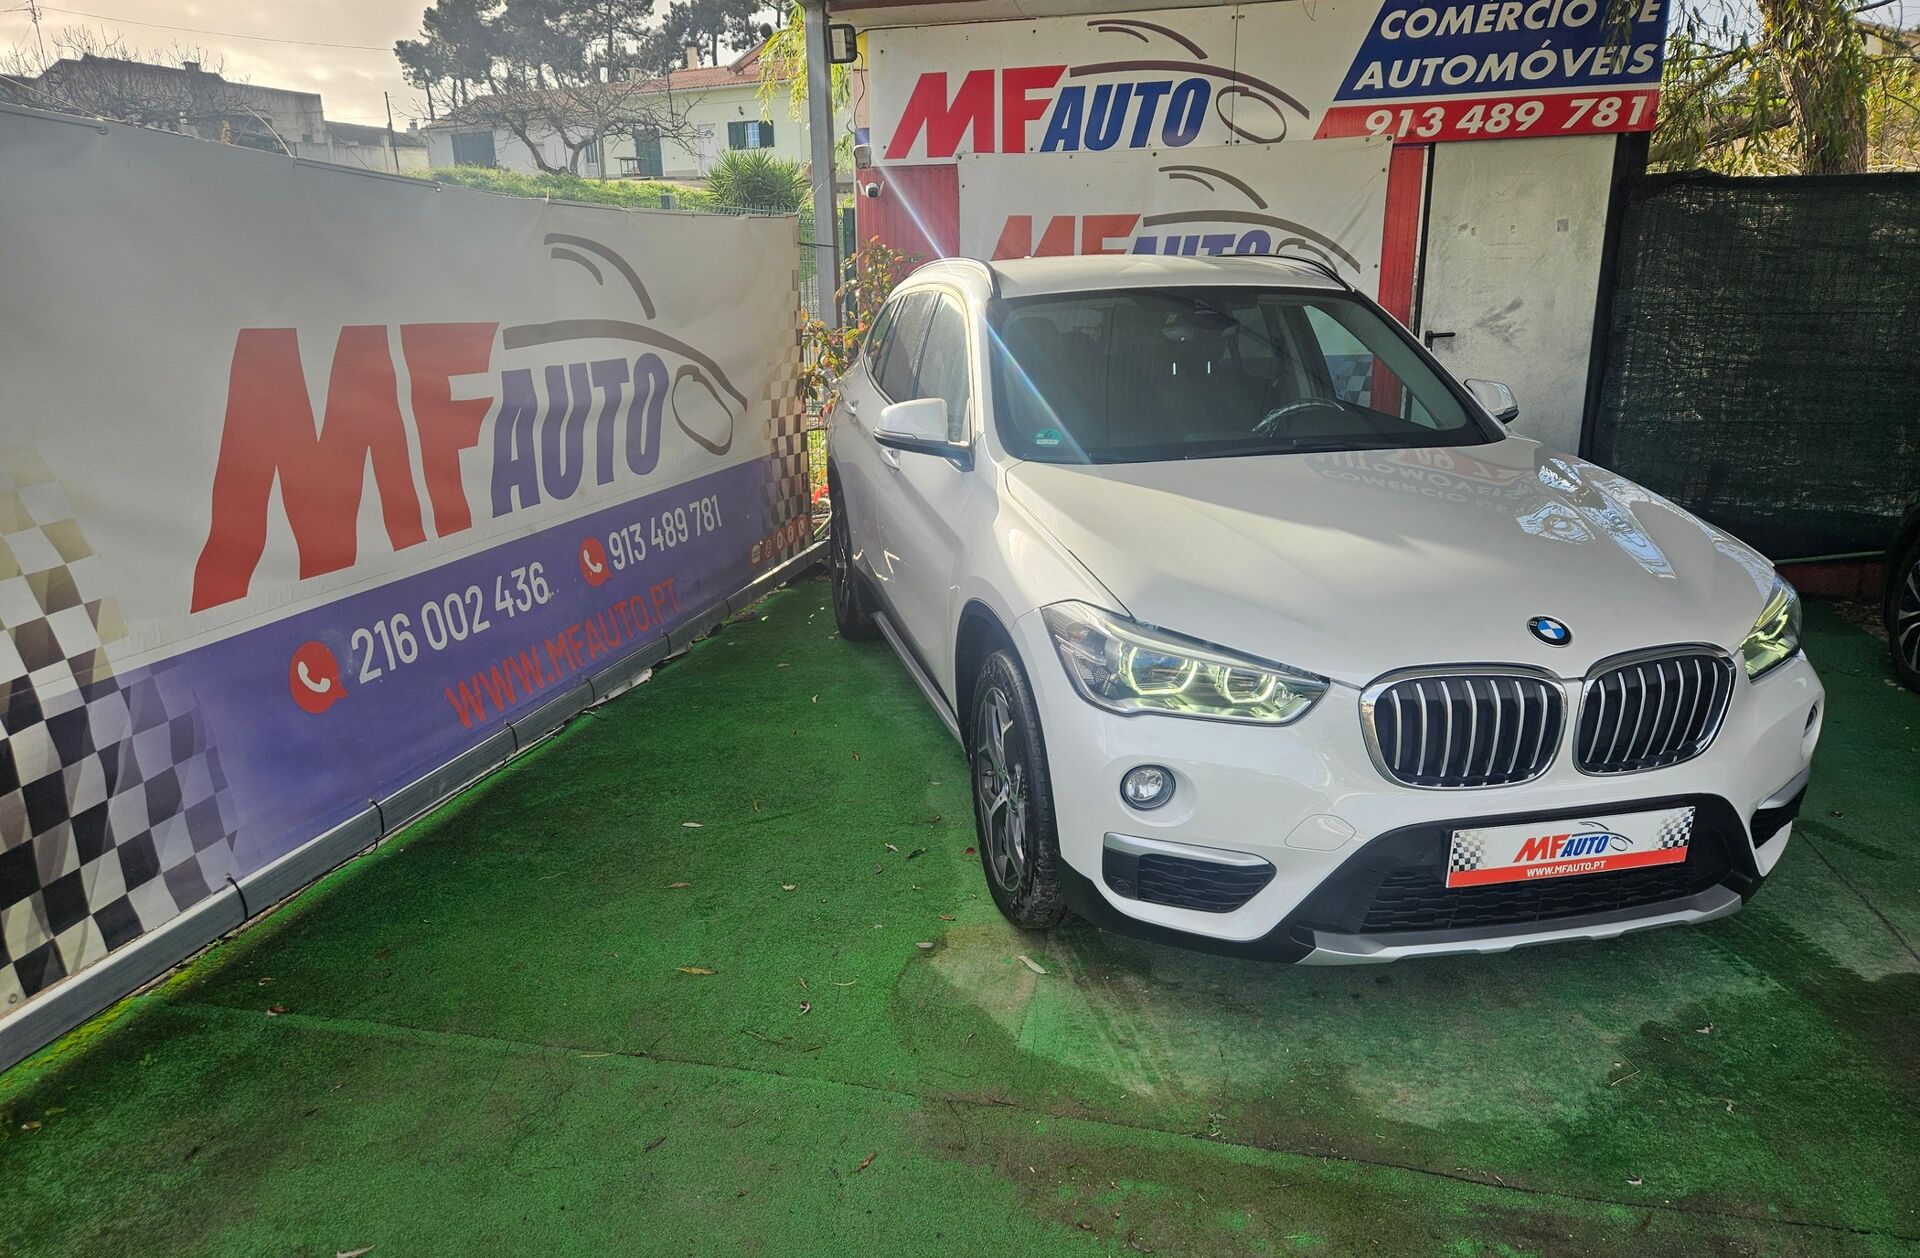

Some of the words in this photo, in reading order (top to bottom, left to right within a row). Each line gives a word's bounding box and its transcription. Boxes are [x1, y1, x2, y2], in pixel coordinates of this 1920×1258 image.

[1353, 40, 1657, 90] AUTOMÓVEIS
[1365, 106, 1445, 138] 913
[1455, 100, 1545, 134] 489
[1561, 95, 1649, 129] 781
[608, 525, 646, 570] 913
[650, 507, 689, 552] 489
[689, 495, 723, 532] 781
[351, 612, 419, 685] 216
[421, 585, 490, 650] 002
[495, 562, 549, 618] 436
[444, 577, 681, 730] WWW.MFAUTO.PT
[1526, 860, 1607, 878] WWW.MFAUTO.PT
